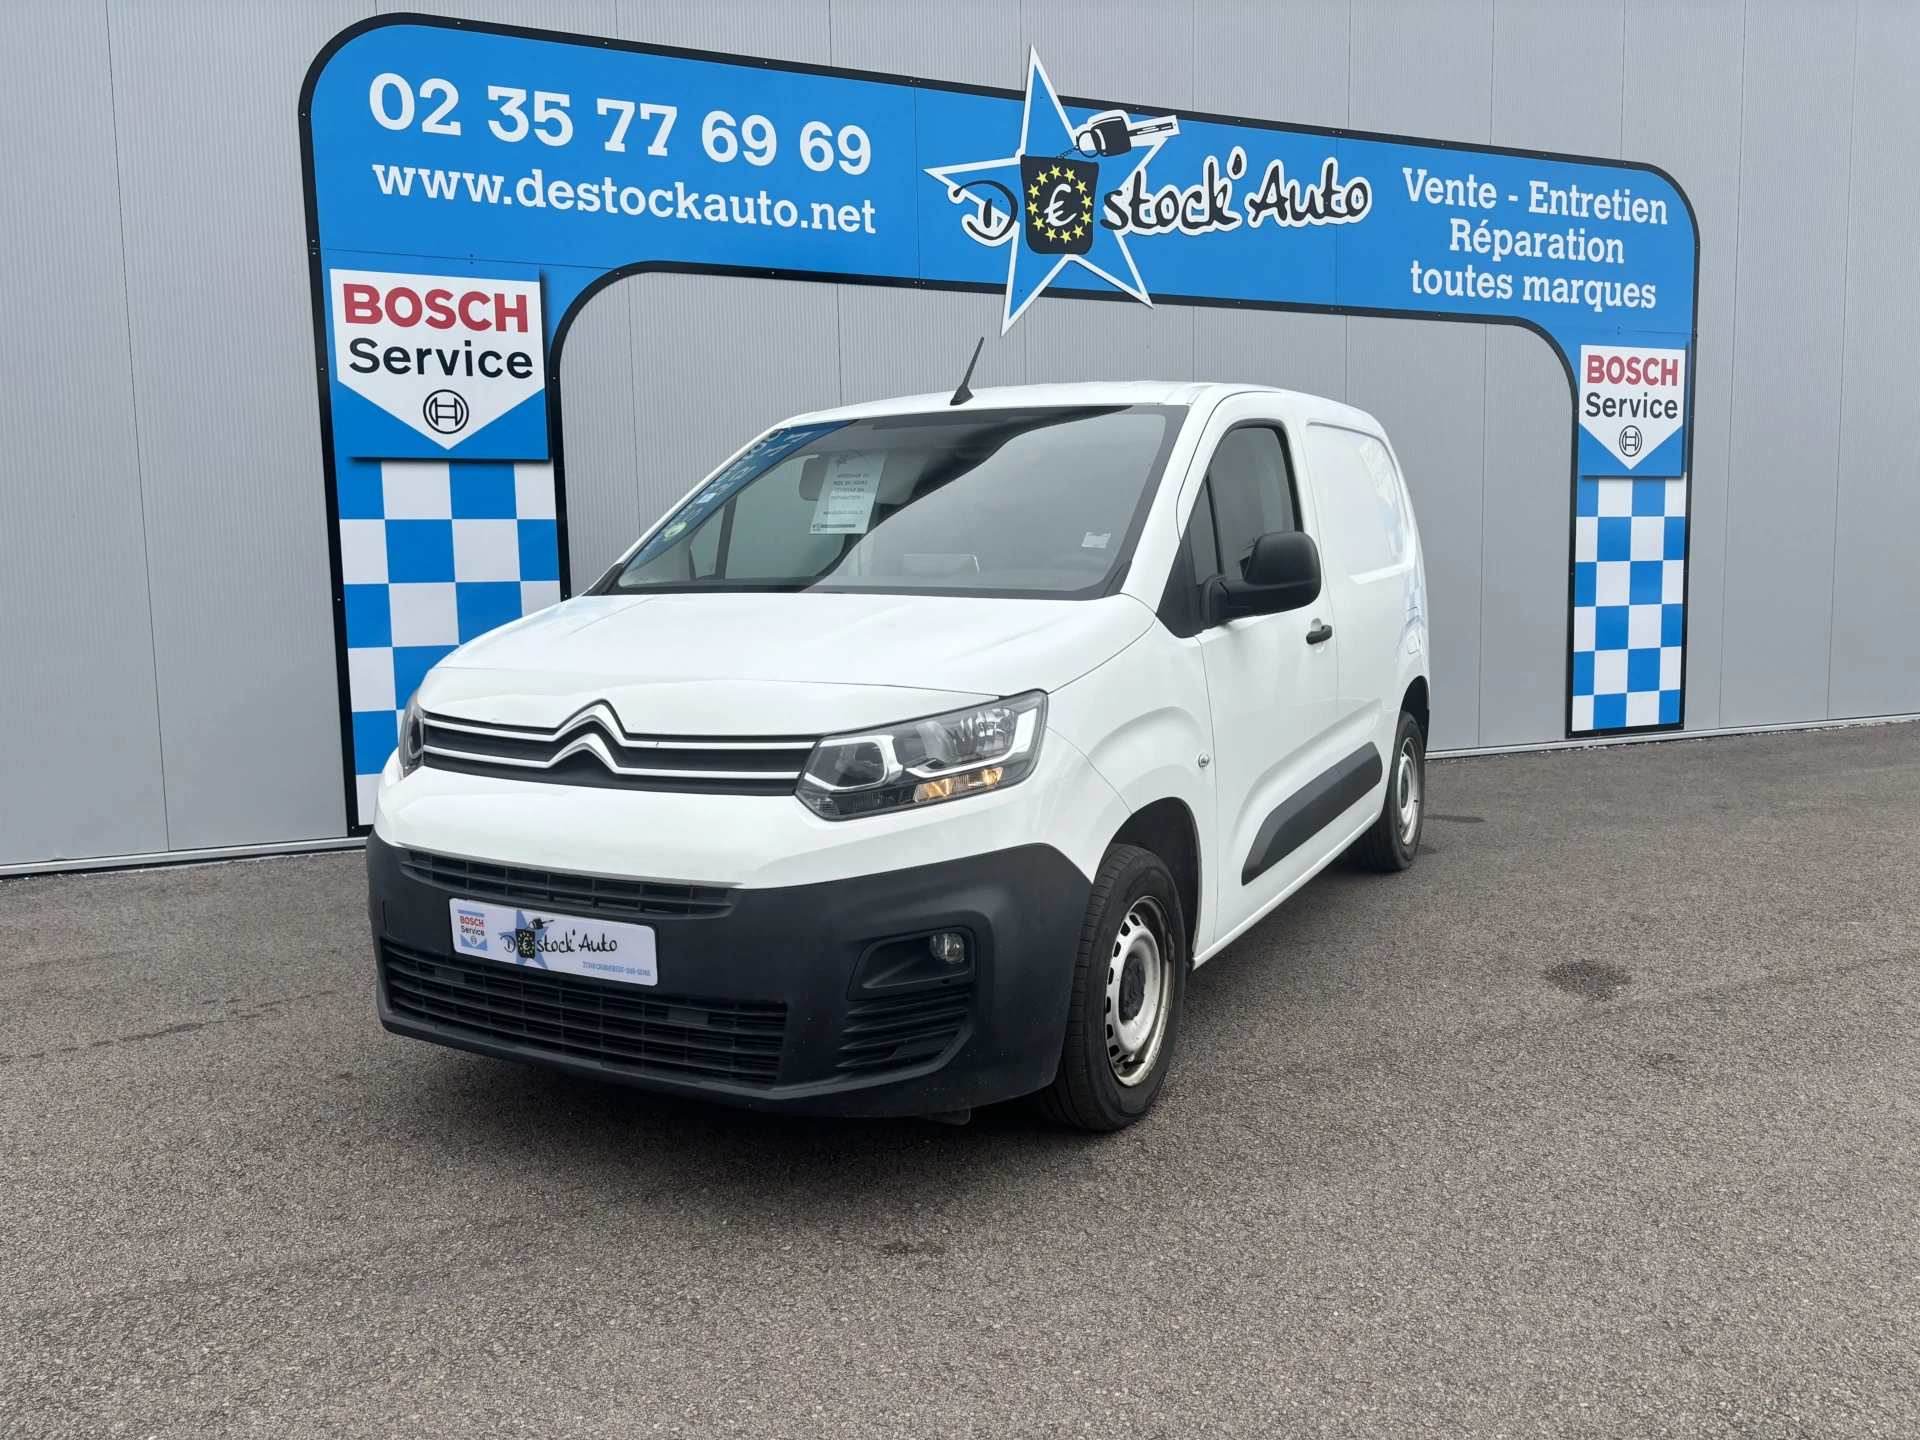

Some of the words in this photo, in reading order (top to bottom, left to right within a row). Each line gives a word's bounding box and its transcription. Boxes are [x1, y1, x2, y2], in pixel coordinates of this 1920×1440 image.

[370, 72, 462, 136] 02
[487, 85, 574, 147] 35
[596, 97, 678, 157] 77
[701, 110, 777, 167] 69
[799, 120, 871, 176] 69
[372, 163, 876, 234] www.destockauto.net
[1402, 167, 1498, 209] Vente
[1528, 180, 1668, 226] Entretien
[1449, 217, 1625, 264] Réparation
[343, 283, 529, 333] BOSCH
[1410, 260, 1513, 303] toutes
[1522, 275, 1657, 315] marques
[349, 337, 533, 379] Service
[1587, 355, 1678, 386] BOSCH
[1585, 392, 1678, 419] Service
[459, 915, 485, 928] BOSCH
[460, 925, 486, 937] Service
